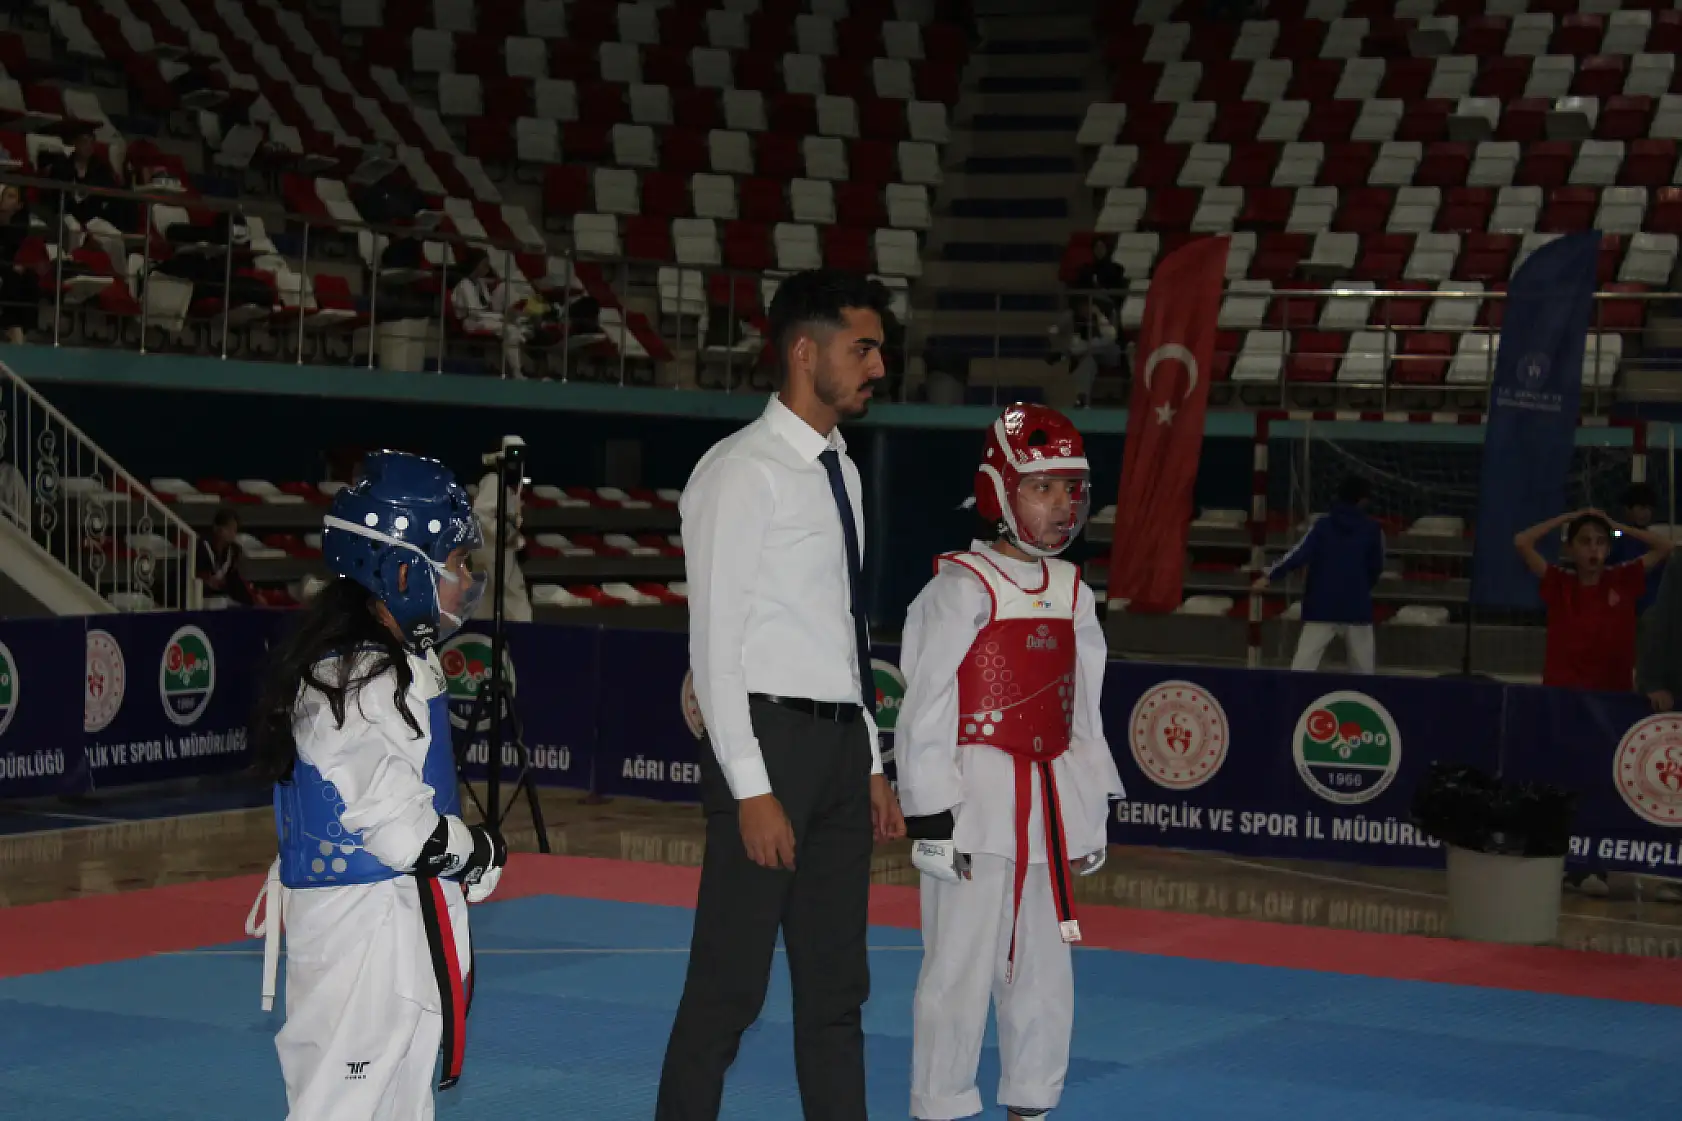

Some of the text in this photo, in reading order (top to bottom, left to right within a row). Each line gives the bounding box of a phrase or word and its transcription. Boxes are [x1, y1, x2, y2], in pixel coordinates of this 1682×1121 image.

[84, 741, 108, 768] LİK
[111, 744, 127, 765] VE
[130, 739, 162, 763] SPOR
[622, 753, 665, 781] AĞRI
[1116, 800, 1202, 832] GENÇLİK
[1208, 807, 1233, 833] VE
[1239, 811, 1298, 838] SPOR
[1305, 810, 1325, 840] İL
